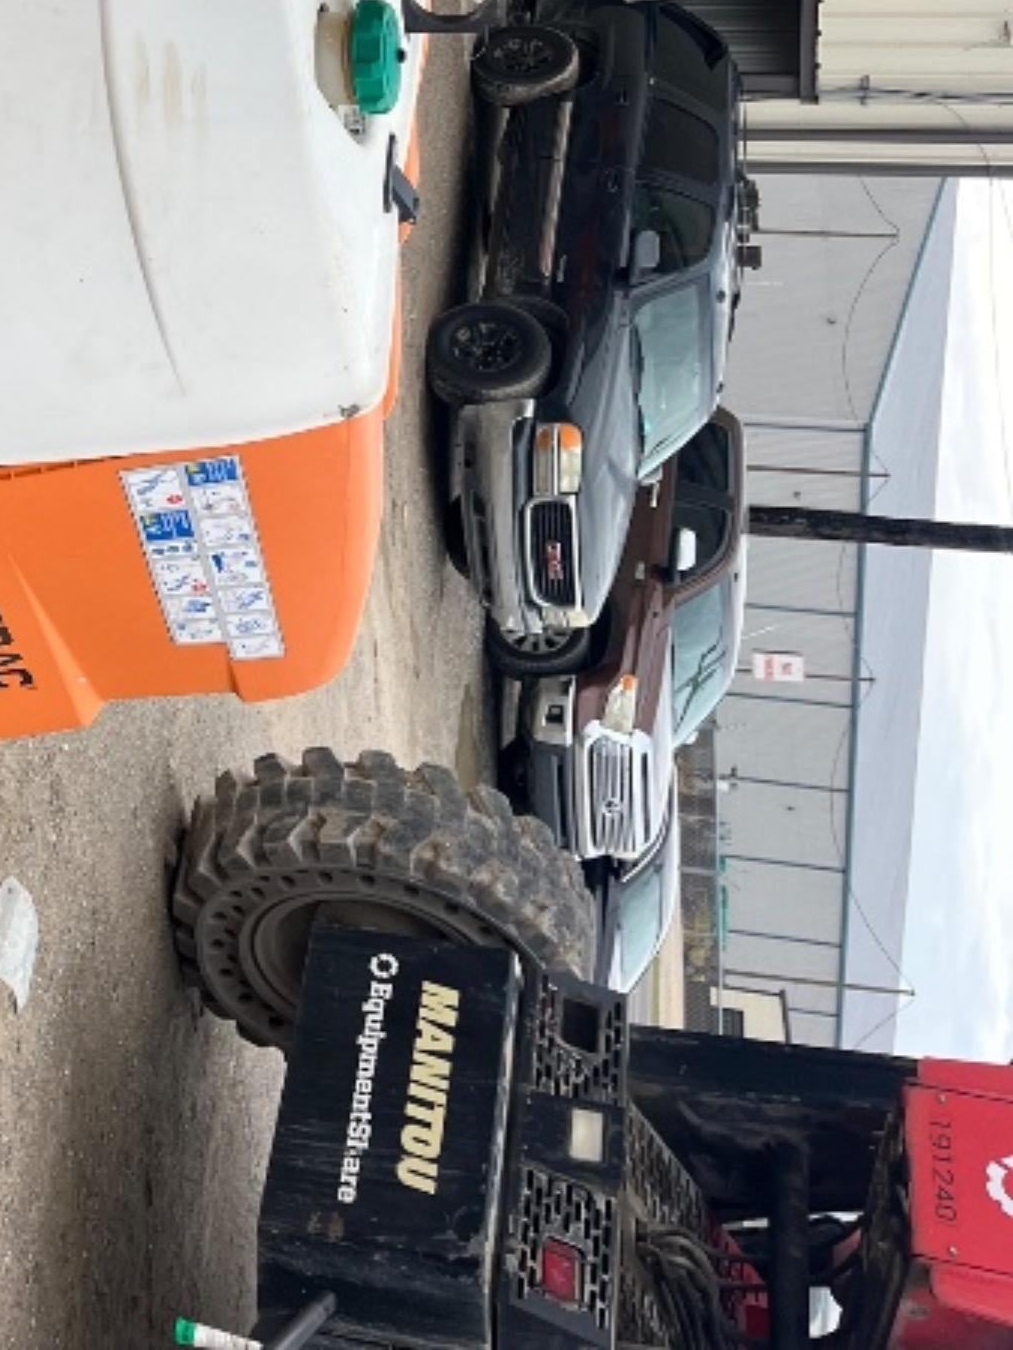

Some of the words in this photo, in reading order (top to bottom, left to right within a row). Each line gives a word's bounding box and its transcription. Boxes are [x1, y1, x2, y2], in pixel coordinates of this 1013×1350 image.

[337, 980, 394, 1204] EquipmentShare
[395, 980, 460, 1194] MANITOU
[929, 1120, 957, 1224] 191240
